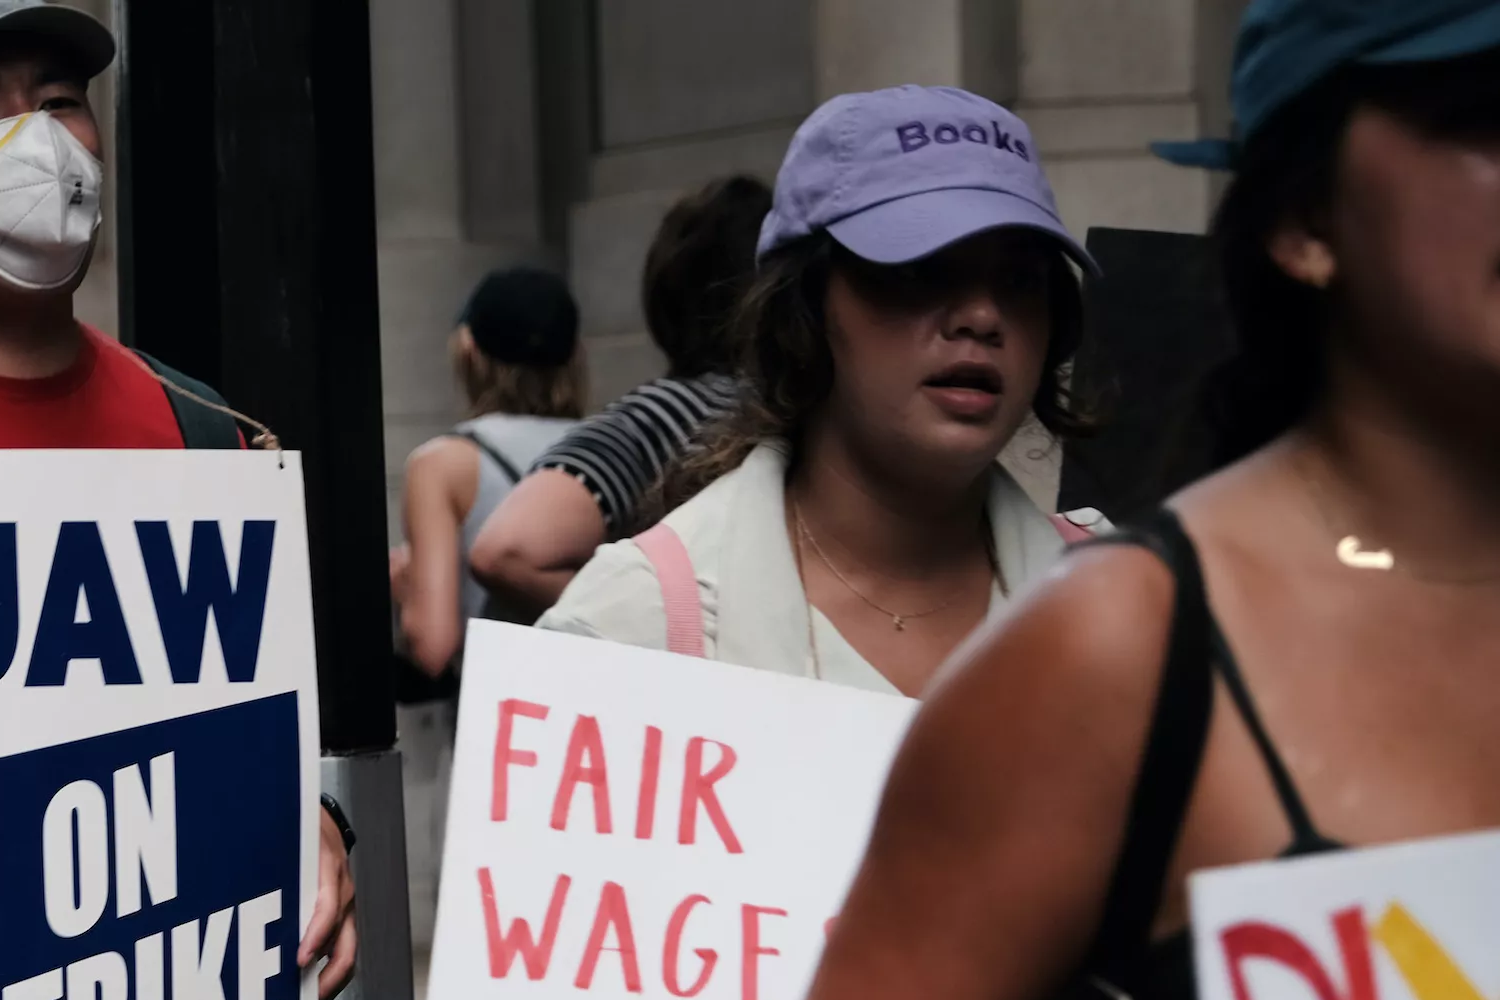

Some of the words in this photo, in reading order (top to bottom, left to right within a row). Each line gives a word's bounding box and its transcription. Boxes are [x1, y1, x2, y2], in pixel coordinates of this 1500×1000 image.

[896, 120, 1030, 163] Books
[42, 751, 178, 938] ON
[490, 698, 743, 854] FAIR
